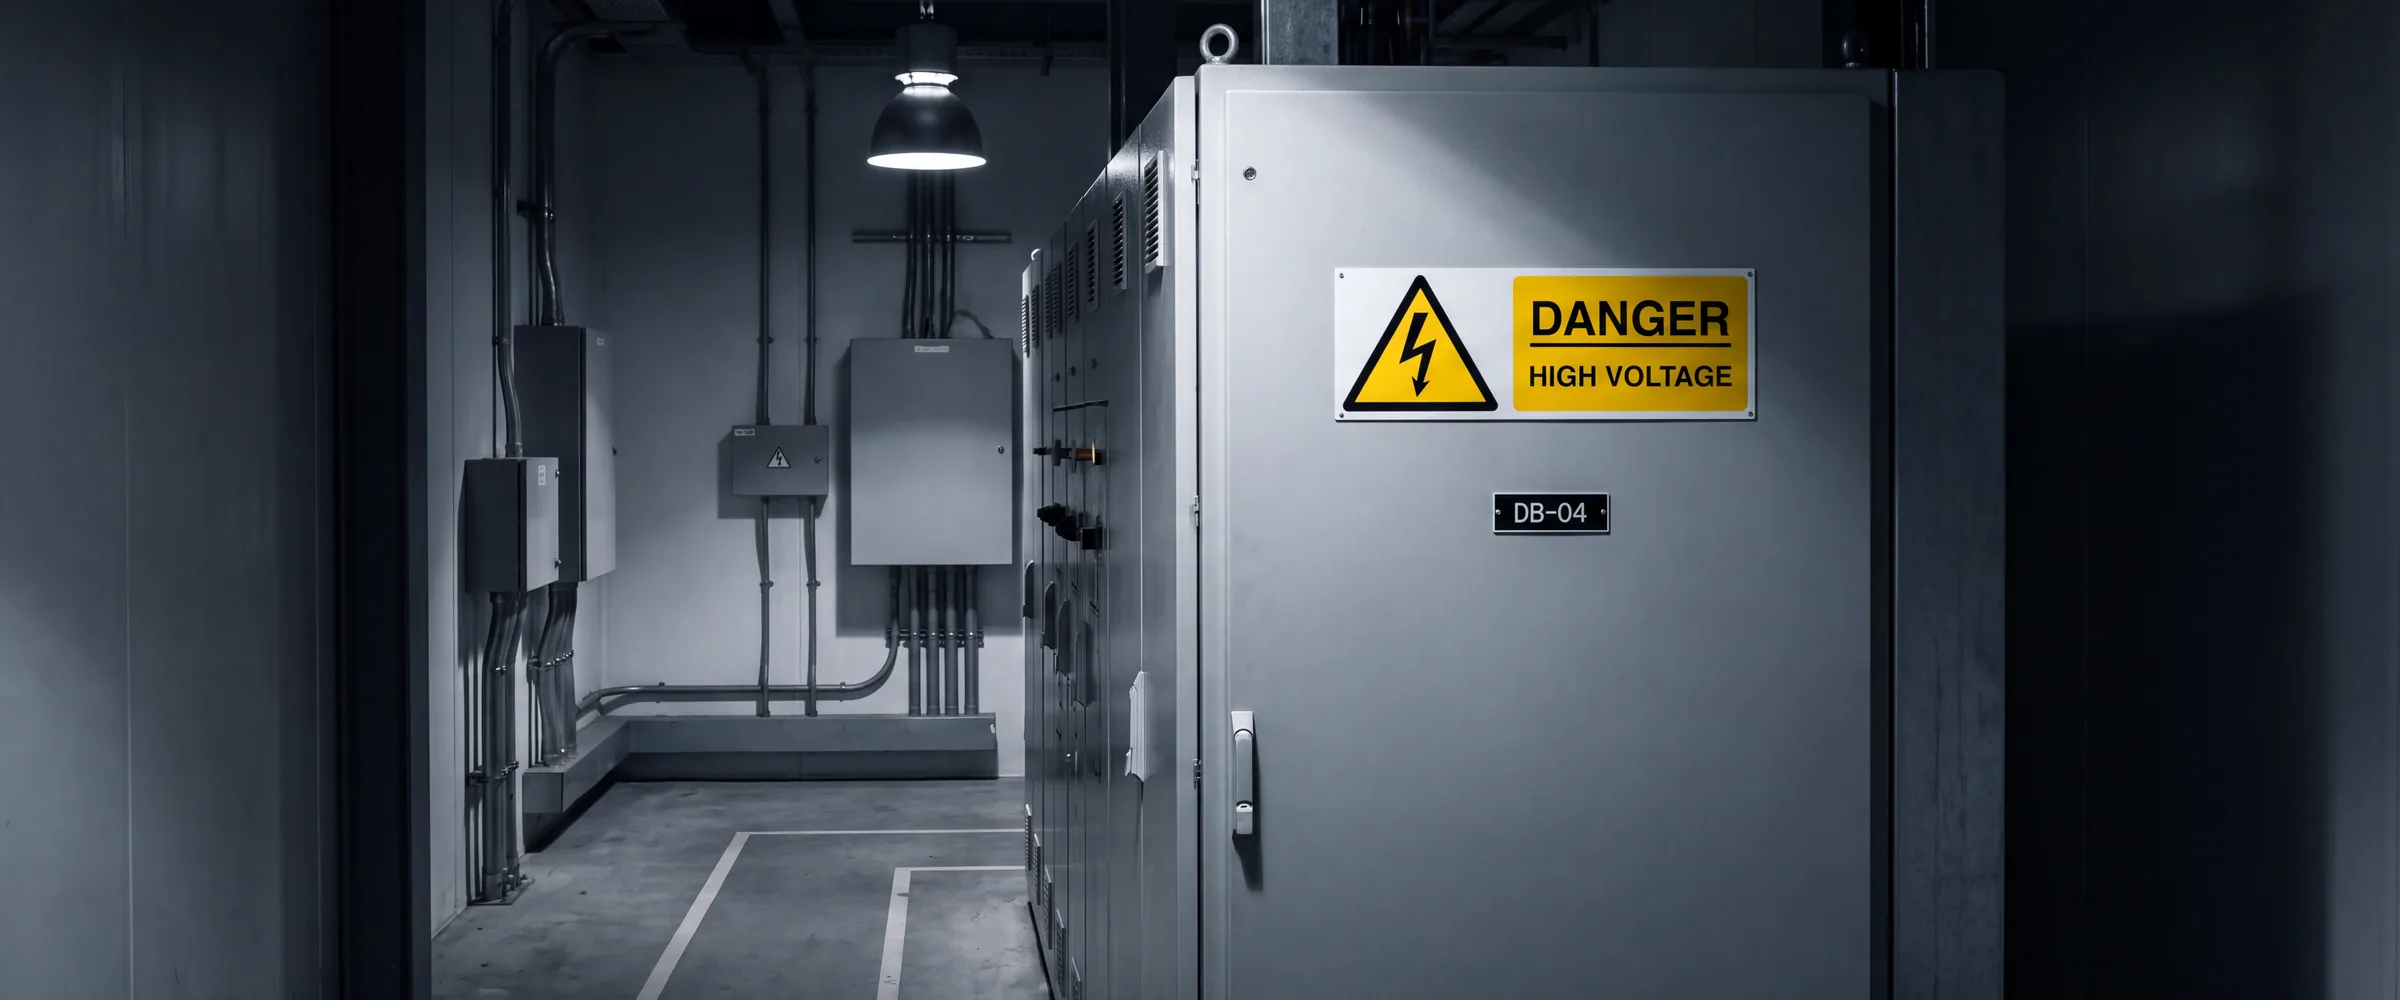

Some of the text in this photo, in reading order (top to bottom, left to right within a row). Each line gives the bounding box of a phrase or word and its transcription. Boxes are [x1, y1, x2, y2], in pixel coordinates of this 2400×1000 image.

[1531, 300, 1730, 337] DANGER
[1529, 365, 1733, 388] HIGH VOLTAGE
[1514, 502, 1588, 523] DB-04
